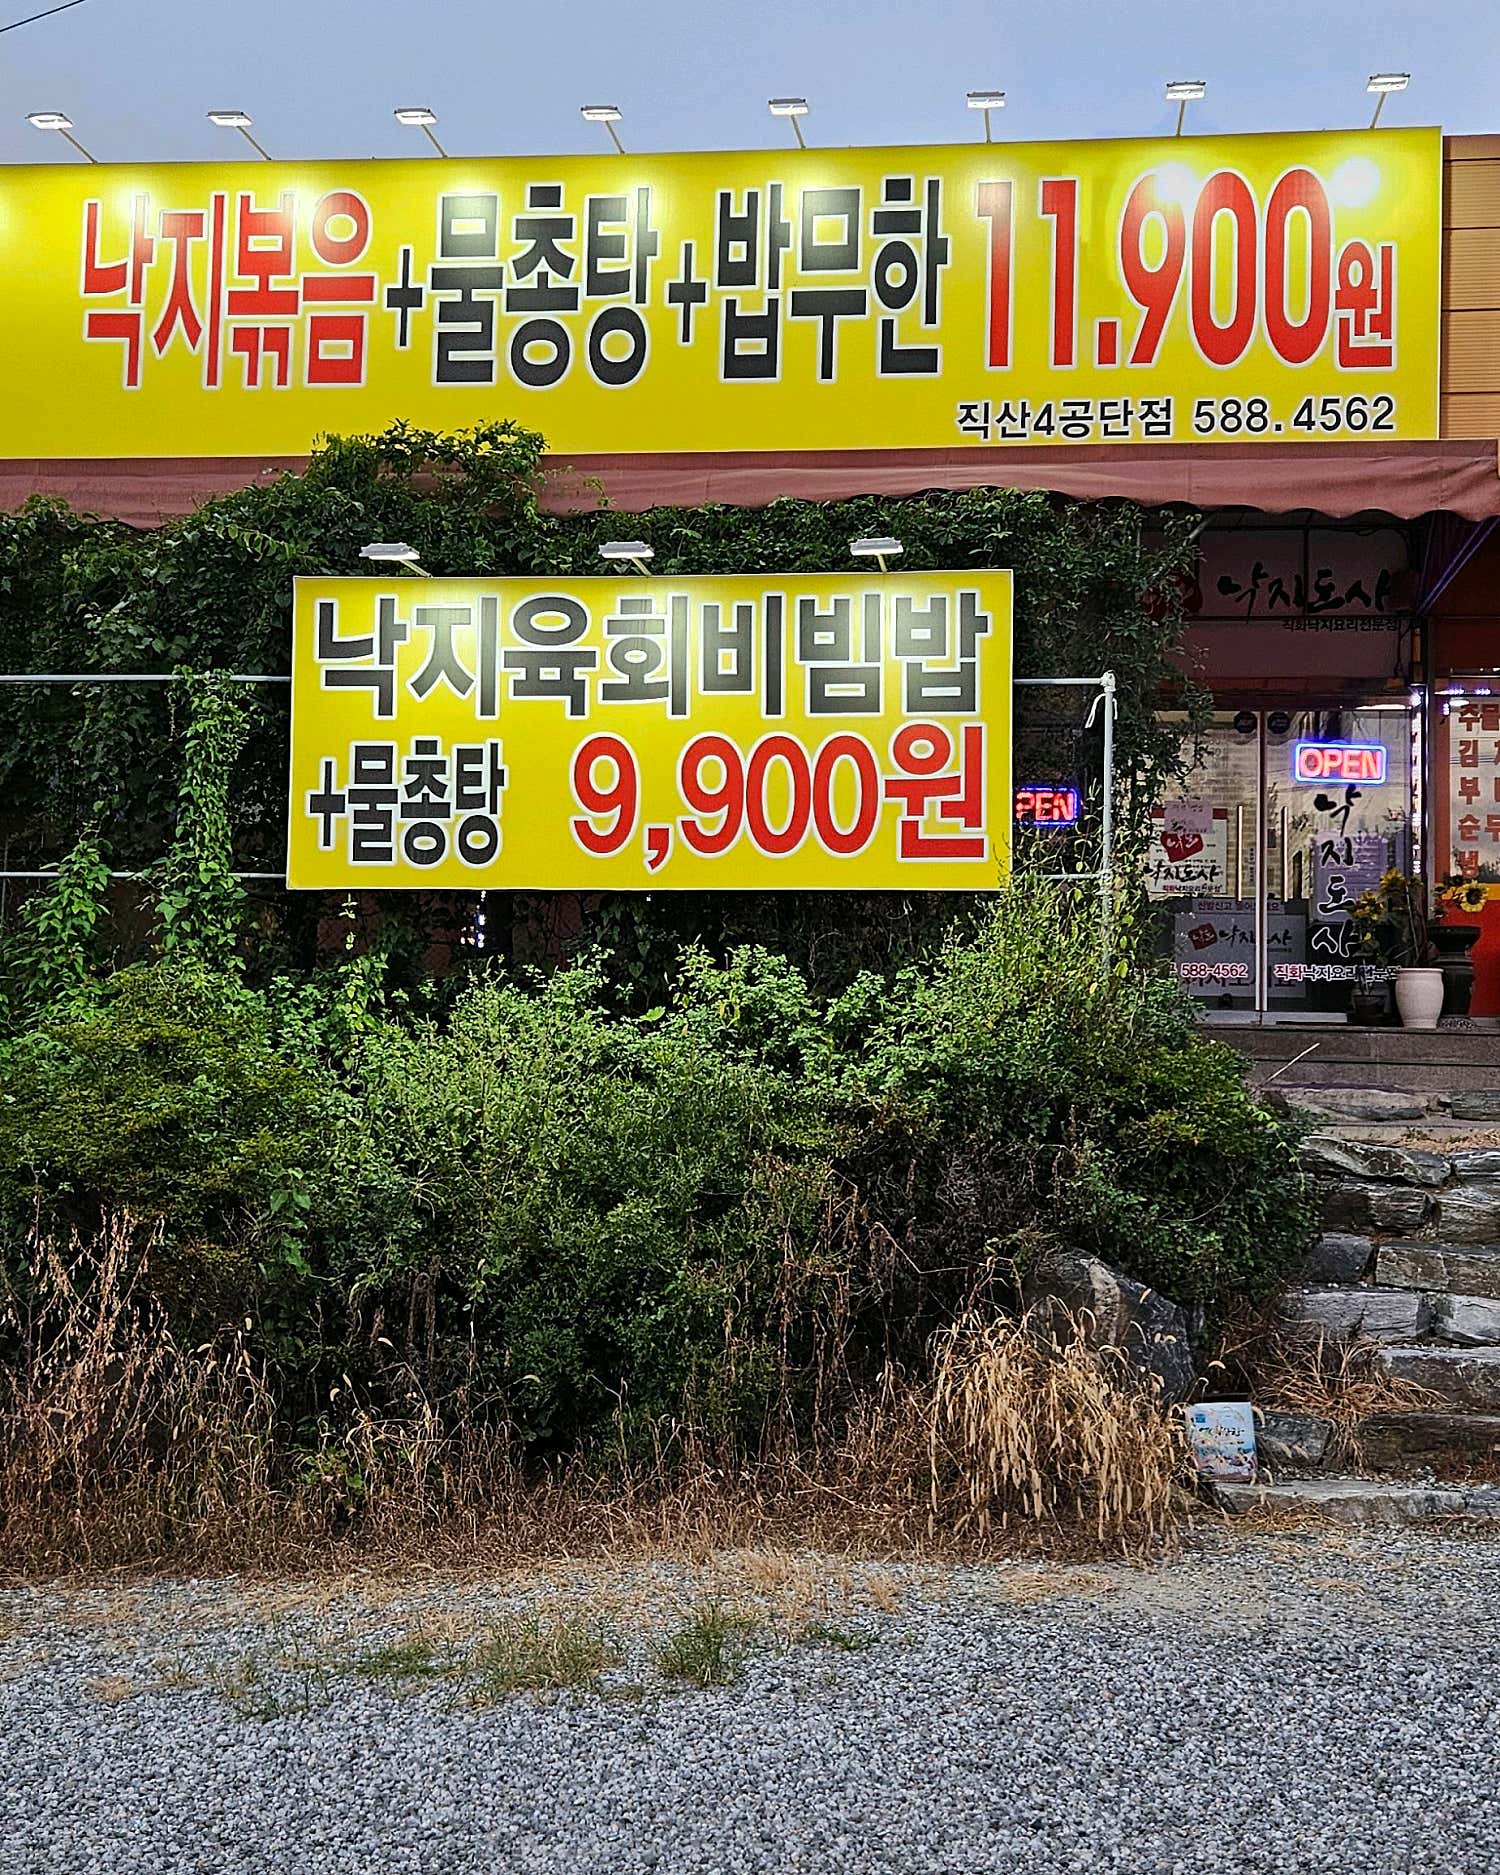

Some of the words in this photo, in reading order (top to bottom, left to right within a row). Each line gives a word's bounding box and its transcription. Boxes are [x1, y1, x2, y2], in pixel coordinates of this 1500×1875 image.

[977, 168, 1394, 370] 11.900원
[957, 399, 1174, 443] 직산4공단점
[1193, 395, 1396, 435] 588.4562
[316, 590, 990, 718] 낙지육회비빔밥
[1299, 748, 1382, 779] OPEN
[572, 722, 986, 872] 9,900원
[1013, 791, 1074, 821] PEN
[1218, 925, 1293, 948] 낙지사
[1181, 962, 1249, 978] 588-4562
